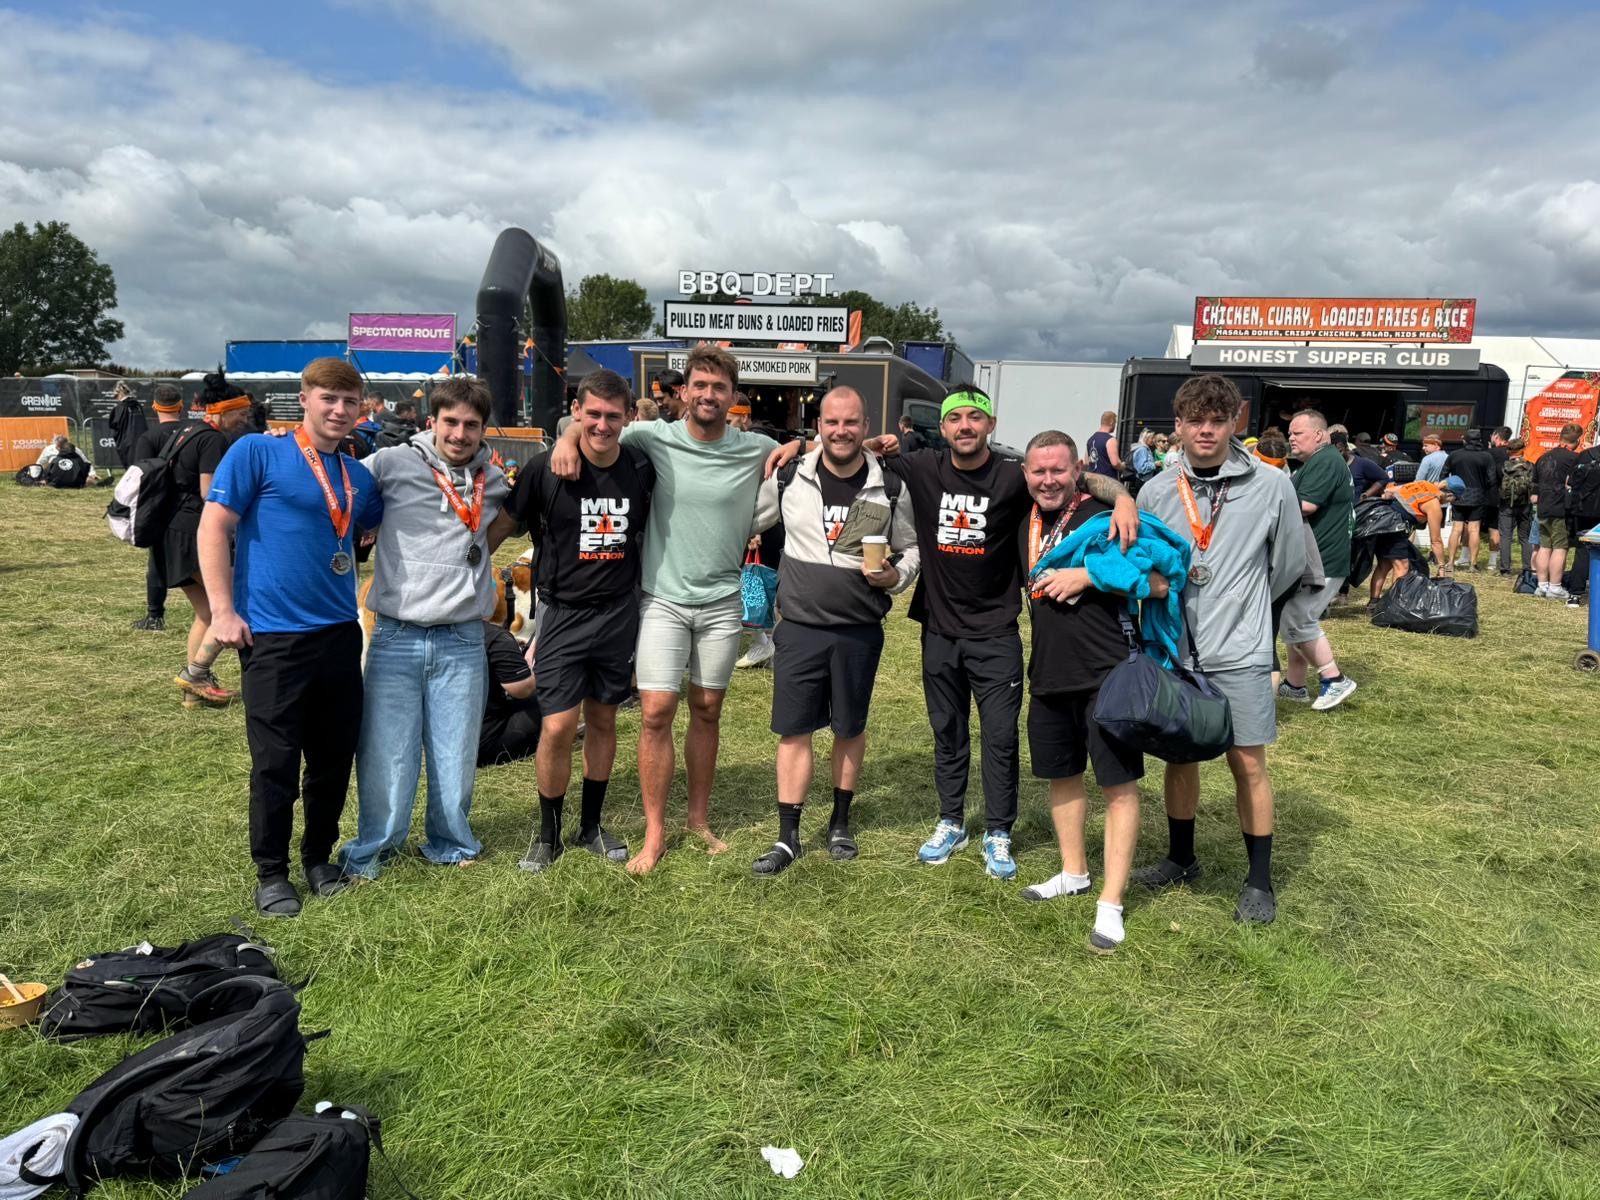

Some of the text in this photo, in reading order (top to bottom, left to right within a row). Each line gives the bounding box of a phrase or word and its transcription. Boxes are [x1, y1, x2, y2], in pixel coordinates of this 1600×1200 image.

[679, 270, 839, 297] BBQ DEPT.
[670, 312, 844, 333] PULLED MEAT BUNS & LOADED FRIES
[1202, 305, 1468, 328] CHICKEN, CURRY, LOADED FRIES & RICE
[352, 326, 450, 338] SPECTATOR ROUTE
[1220, 349, 1450, 366] HONEST SUPPER CLUB
[753, 361, 787, 373] SMOKED
[788, 362, 811, 374] PORK
[581, 497, 630, 515] MU
[941, 492, 990, 513] MU
[579, 552, 625, 560] NATION
[937, 544, 985, 555] NATION
